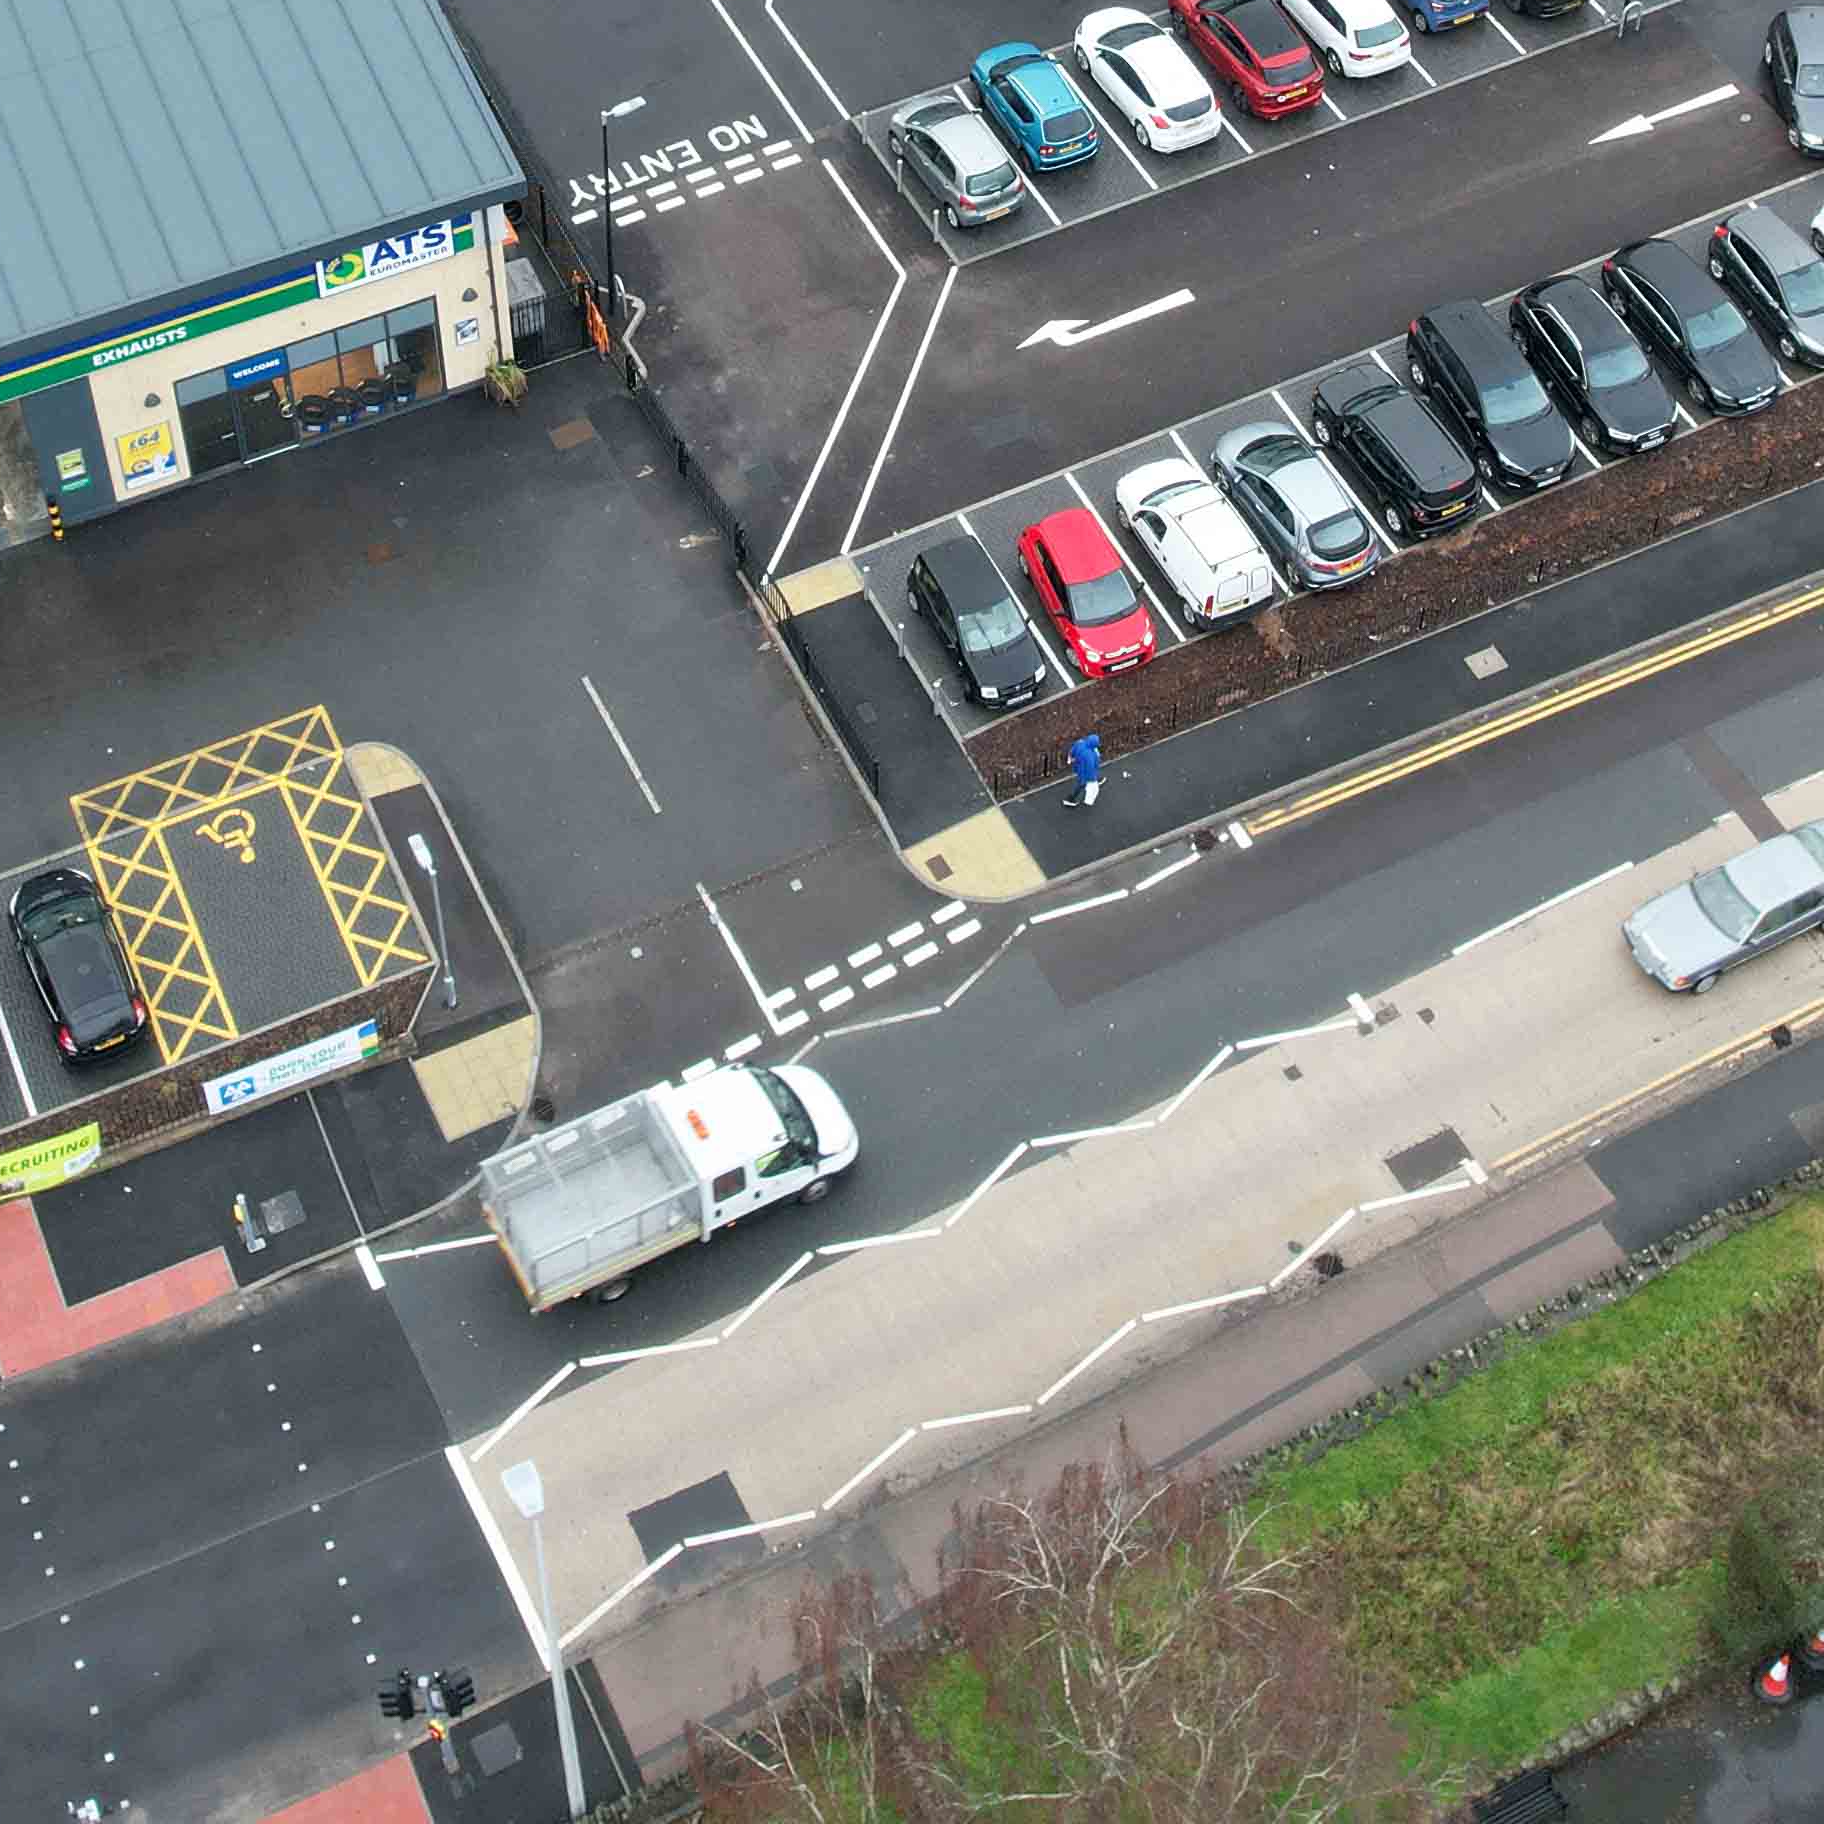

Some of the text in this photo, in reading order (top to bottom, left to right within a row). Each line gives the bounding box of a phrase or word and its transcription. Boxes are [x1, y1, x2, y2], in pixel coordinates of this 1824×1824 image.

[568, 113, 769, 208] NO ENTRY
[369, 246, 449, 276] EUROMASTER
[370, 223, 447, 267] ATS
[92, 325, 188, 367] EXHAUSTS
[232, 358, 281, 380] WELCOME
